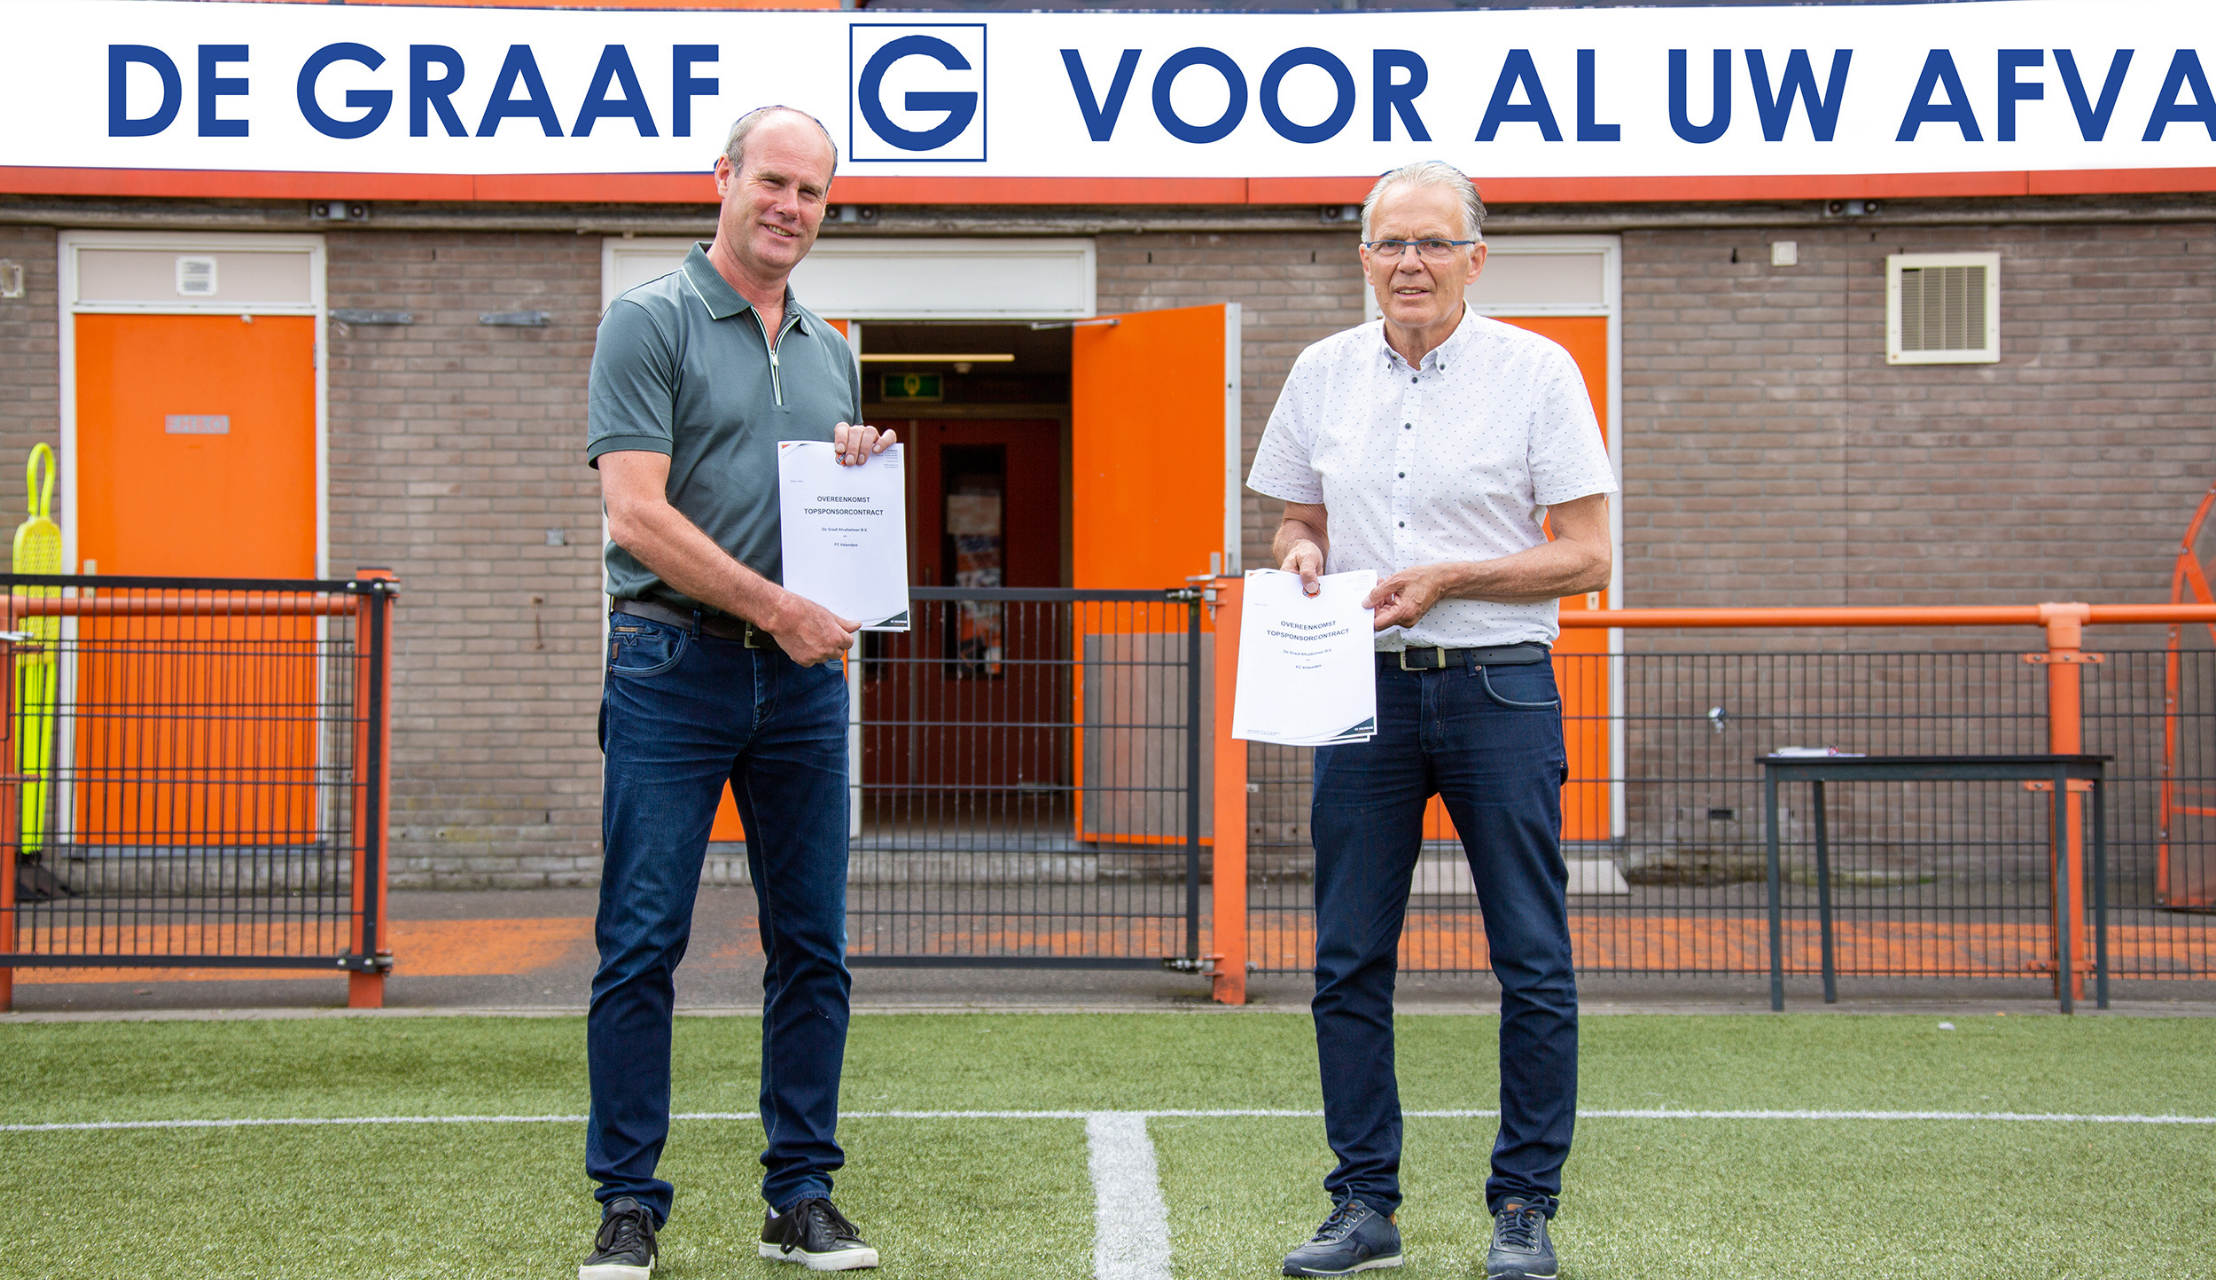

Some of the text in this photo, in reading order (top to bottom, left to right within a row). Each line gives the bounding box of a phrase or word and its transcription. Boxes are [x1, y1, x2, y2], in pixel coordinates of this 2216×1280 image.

[108, 41, 719, 140] DE GRAAF
[857, 34, 979, 152] G
[1059, 46, 2216, 145] VOOR AL UW AFVA
[1267, 628, 1349, 641] TOPSPONSORCONTRACT
[1280, 620, 1336, 630] OVEREENKOMST
